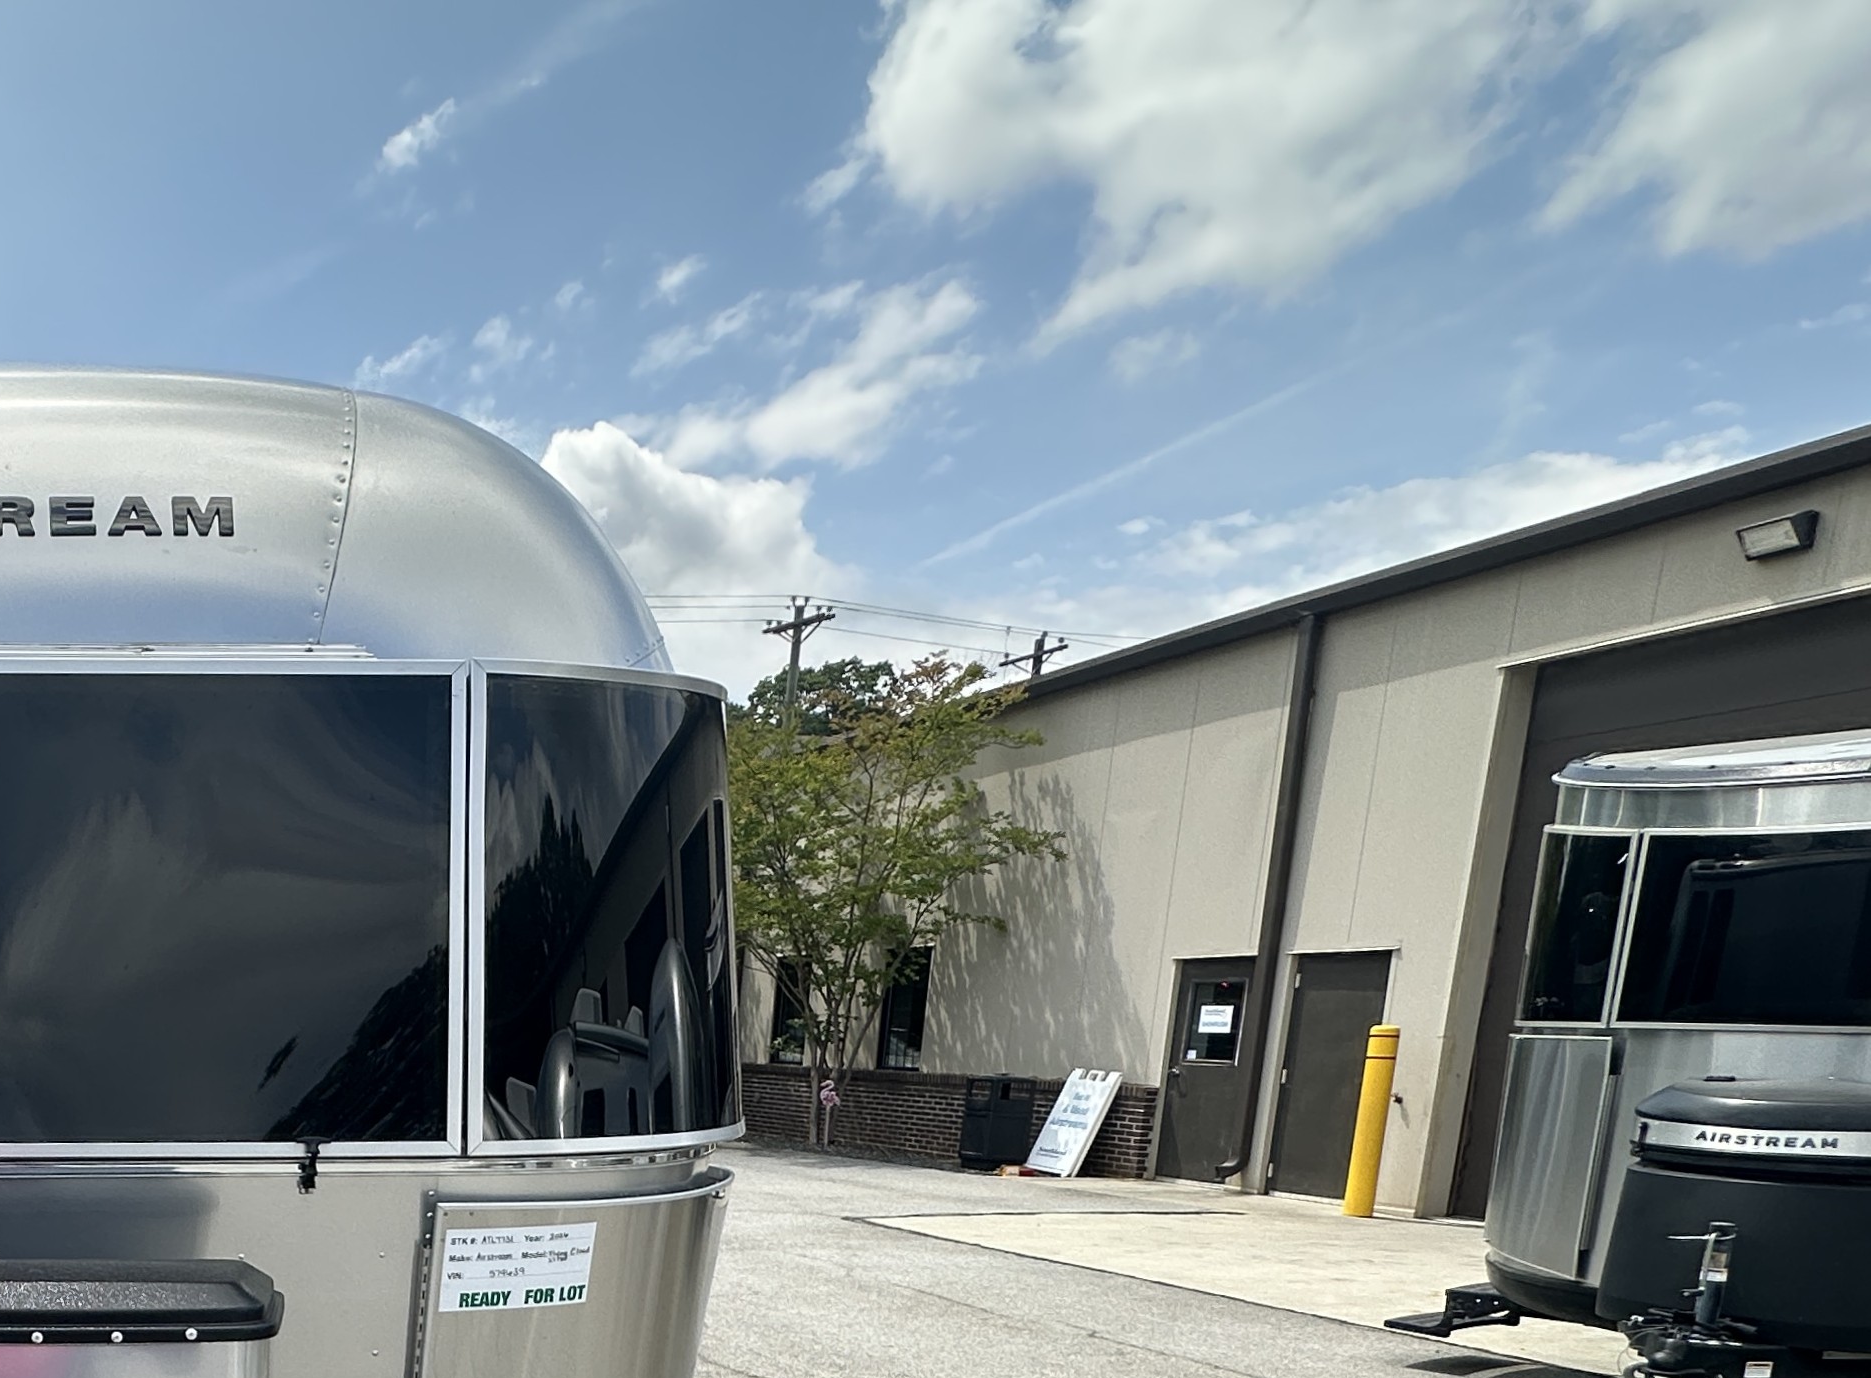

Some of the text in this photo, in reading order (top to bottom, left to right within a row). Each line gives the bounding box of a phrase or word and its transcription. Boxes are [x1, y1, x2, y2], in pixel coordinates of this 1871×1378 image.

[1695, 1130, 1839, 1149] AIRSTREAM
[450, 1237, 468, 1246] STK
[524, 1234, 545, 1242] Year:
[447, 1271, 464, 1280] VIN:
[459, 1284, 586, 1308] READY FOR LOT
